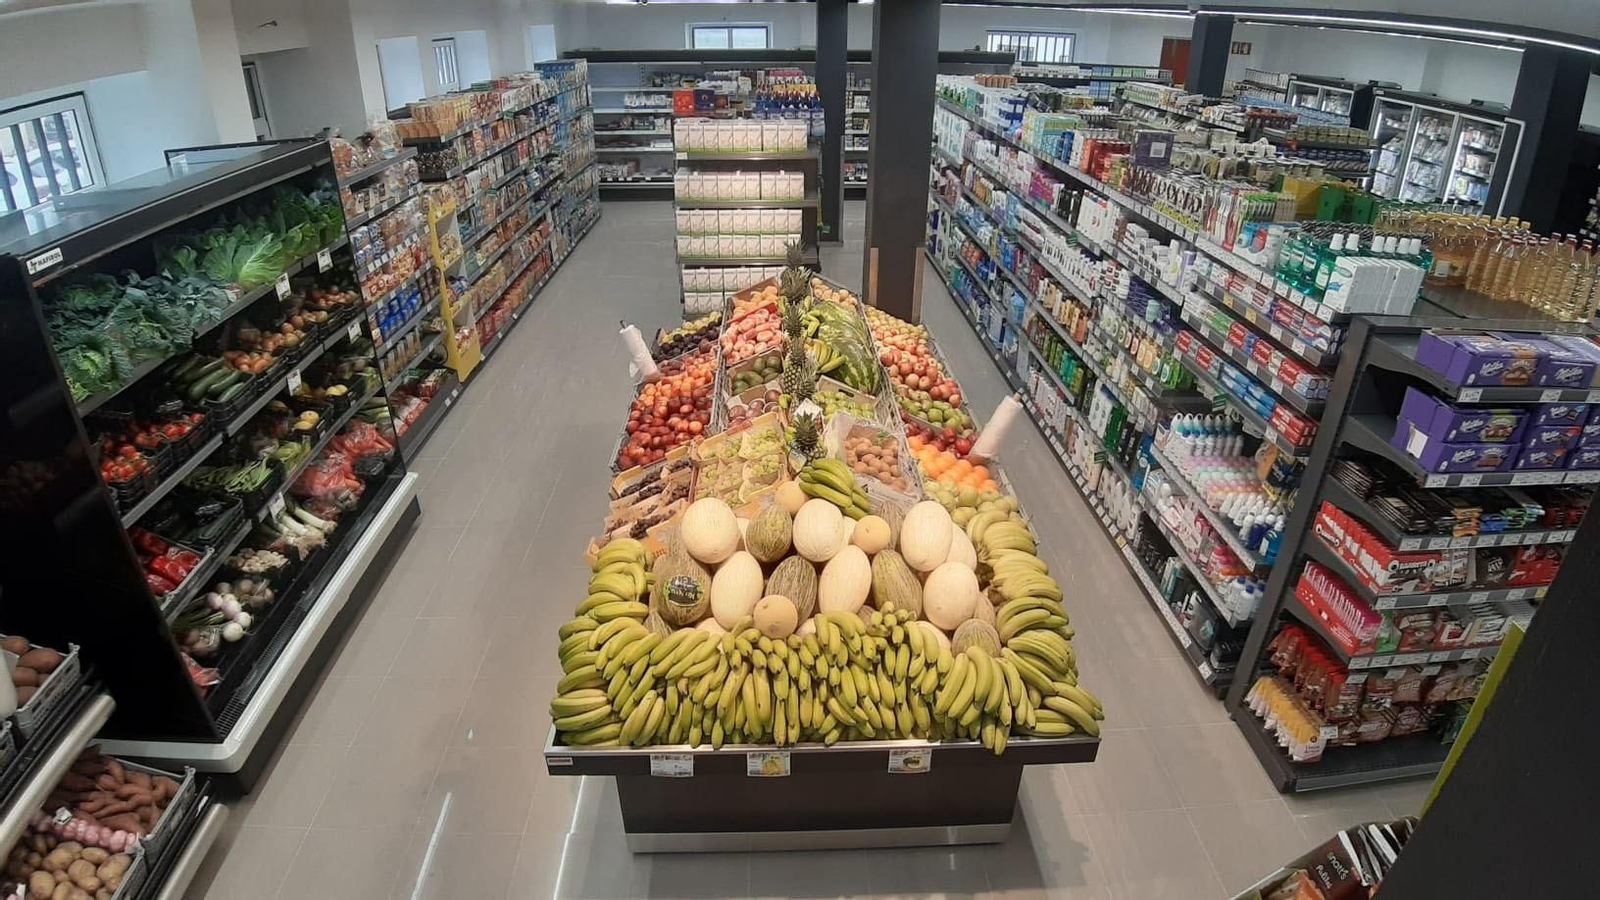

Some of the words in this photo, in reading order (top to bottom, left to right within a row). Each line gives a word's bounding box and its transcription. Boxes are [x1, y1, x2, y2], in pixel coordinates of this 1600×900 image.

[1479, 360, 1505, 376] Milka
[1555, 366, 1583, 380] Milka
[1460, 418, 1484, 432] Milka
[1451, 448, 1477, 463] Milka
